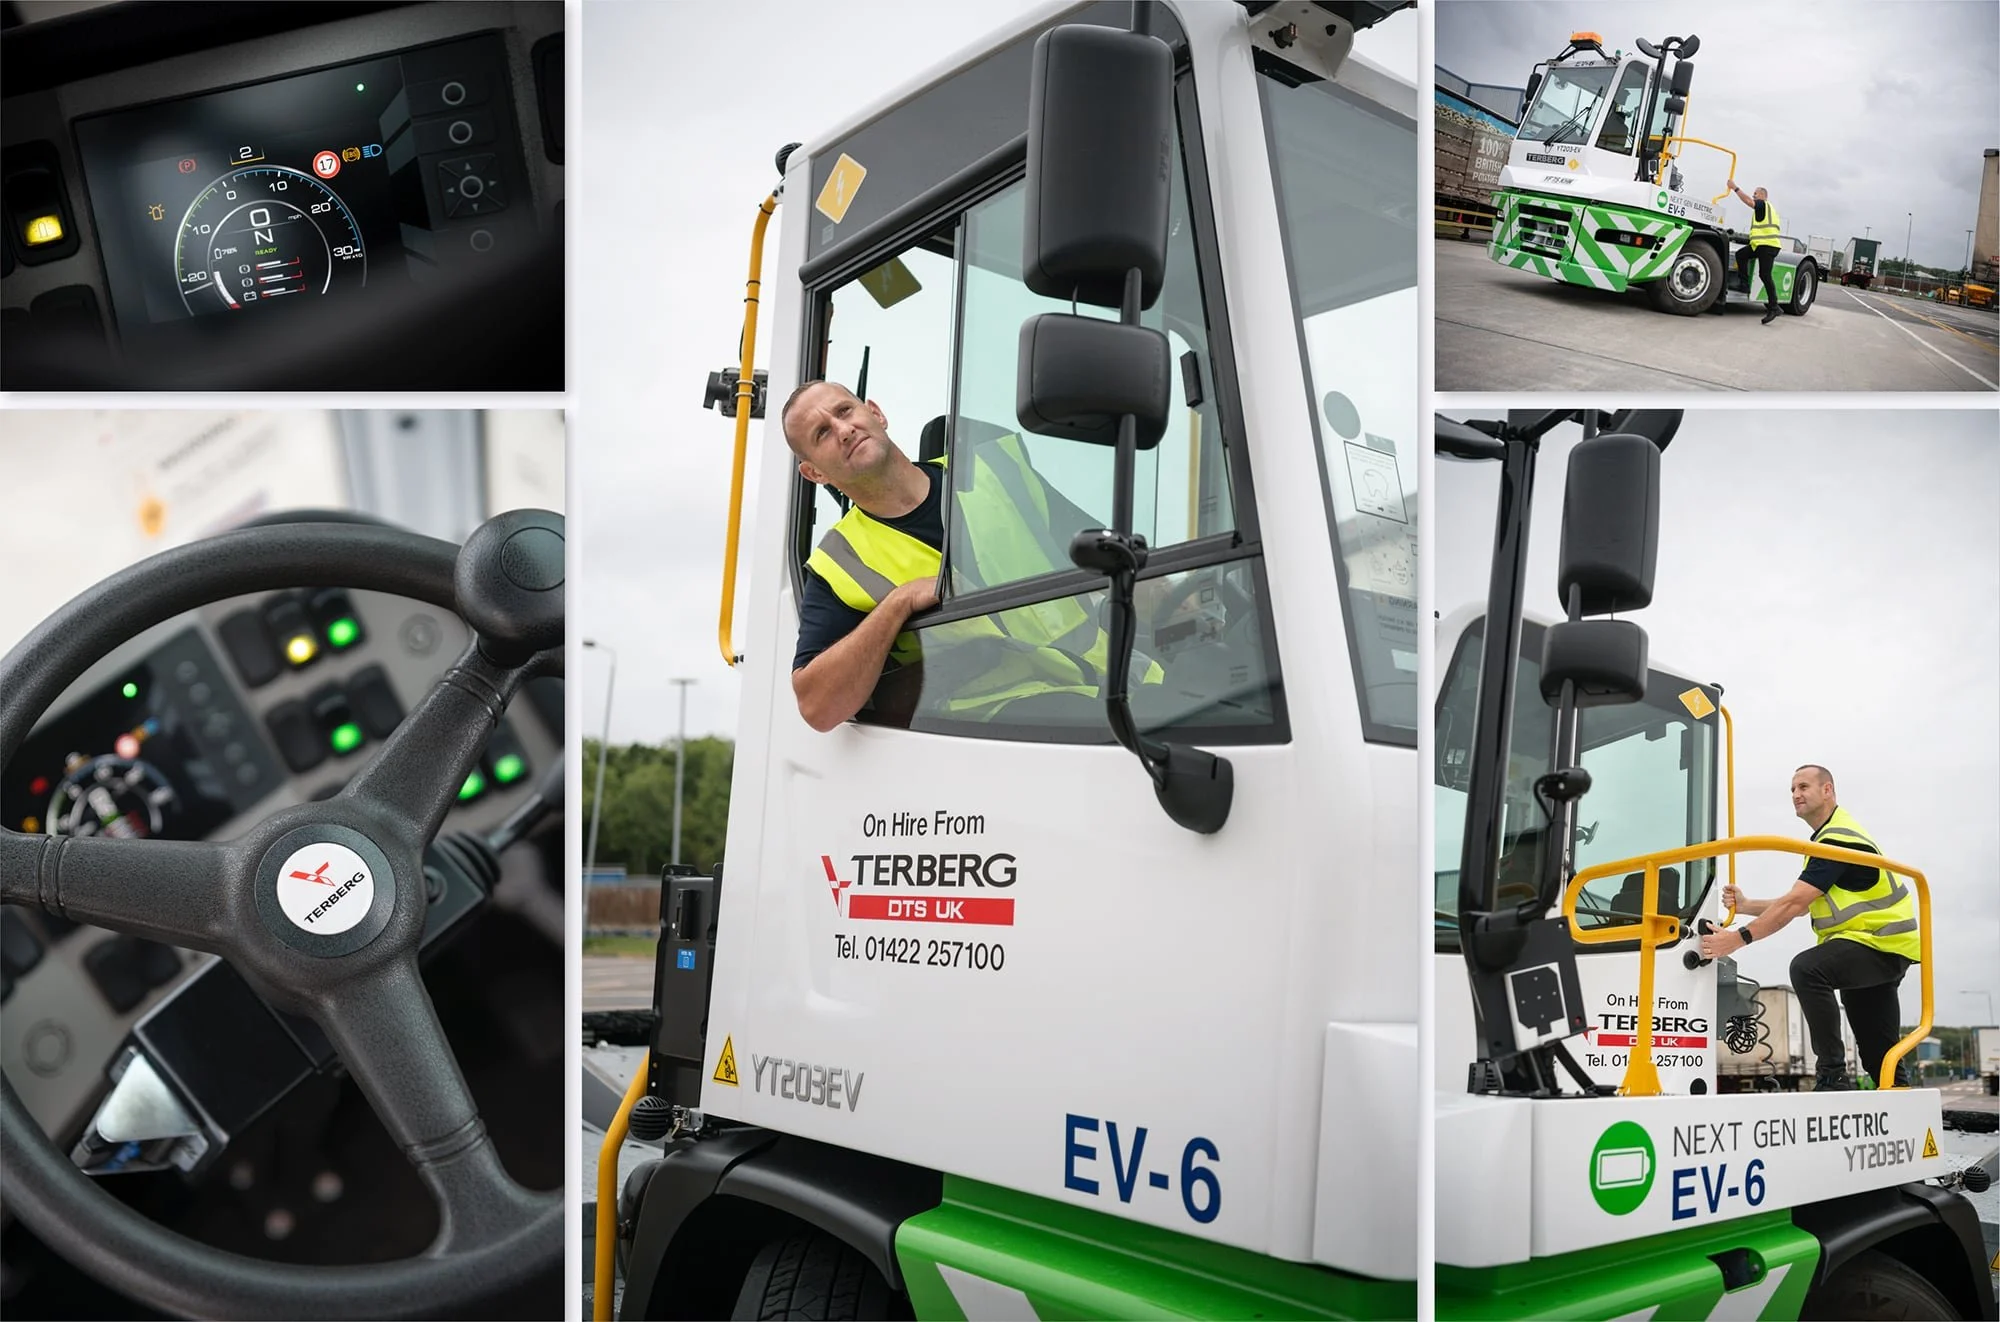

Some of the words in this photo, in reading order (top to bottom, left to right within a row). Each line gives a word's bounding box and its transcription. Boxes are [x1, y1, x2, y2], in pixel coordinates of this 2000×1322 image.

[240, 146, 253, 159] 2
[1477, 137, 1505, 159] 100%
[320, 158, 333, 171] 17
[1475, 157, 1503, 173] BRITISH
[1527, 154, 1564, 165] TERBERG
[226, 190, 237, 200] 0
[269, 181, 288, 192] 10
[311, 202, 331, 214] 20
[1668, 203, 1686, 217] EV-6
[1670, 195, 1683, 204] NEXT
[1683, 199, 1693, 208] GEN
[1693, 203, 1713, 214] ELECTRIC
[250, 208, 270, 227] 0
[193, 224, 210, 235] 10
[254, 228, 274, 245] N
[255, 247, 278, 256] READY
[333, 245, 353, 257] 30
[187, 271, 207, 283] 20
[863, 813, 886, 837] On
[892, 812, 928, 837] Hire
[934, 810, 985, 836] From
[851, 853, 1017, 888] TERBERG
[304, 871, 366, 924] TERBERG
[888, 899, 927, 918] DTS
[936, 901, 964, 920] UK
[835, 934, 859, 960] Tel.
[865, 935, 921, 964] 01422
[927, 939, 1005, 971] 257100
[1607, 993, 1625, 1007] On
[1658, 997, 1689, 1010] From
[1661, 1037, 1678, 1047] UK
[1585, 1054, 1607, 1067] Tel.
[1656, 1055, 1703, 1067] 257100
[752, 1053, 864, 1112] YT203EV
[1673, 1121, 1743, 1157] NEXT
[1753, 1118, 1796, 1148] GEN
[1807, 1111, 1889, 1143] ELECTRIC
[1844, 1138, 1916, 1172] YT203EV
[1064, 1113, 1222, 1224] EV-6
[1672, 1158, 1766, 1221] EV-6
